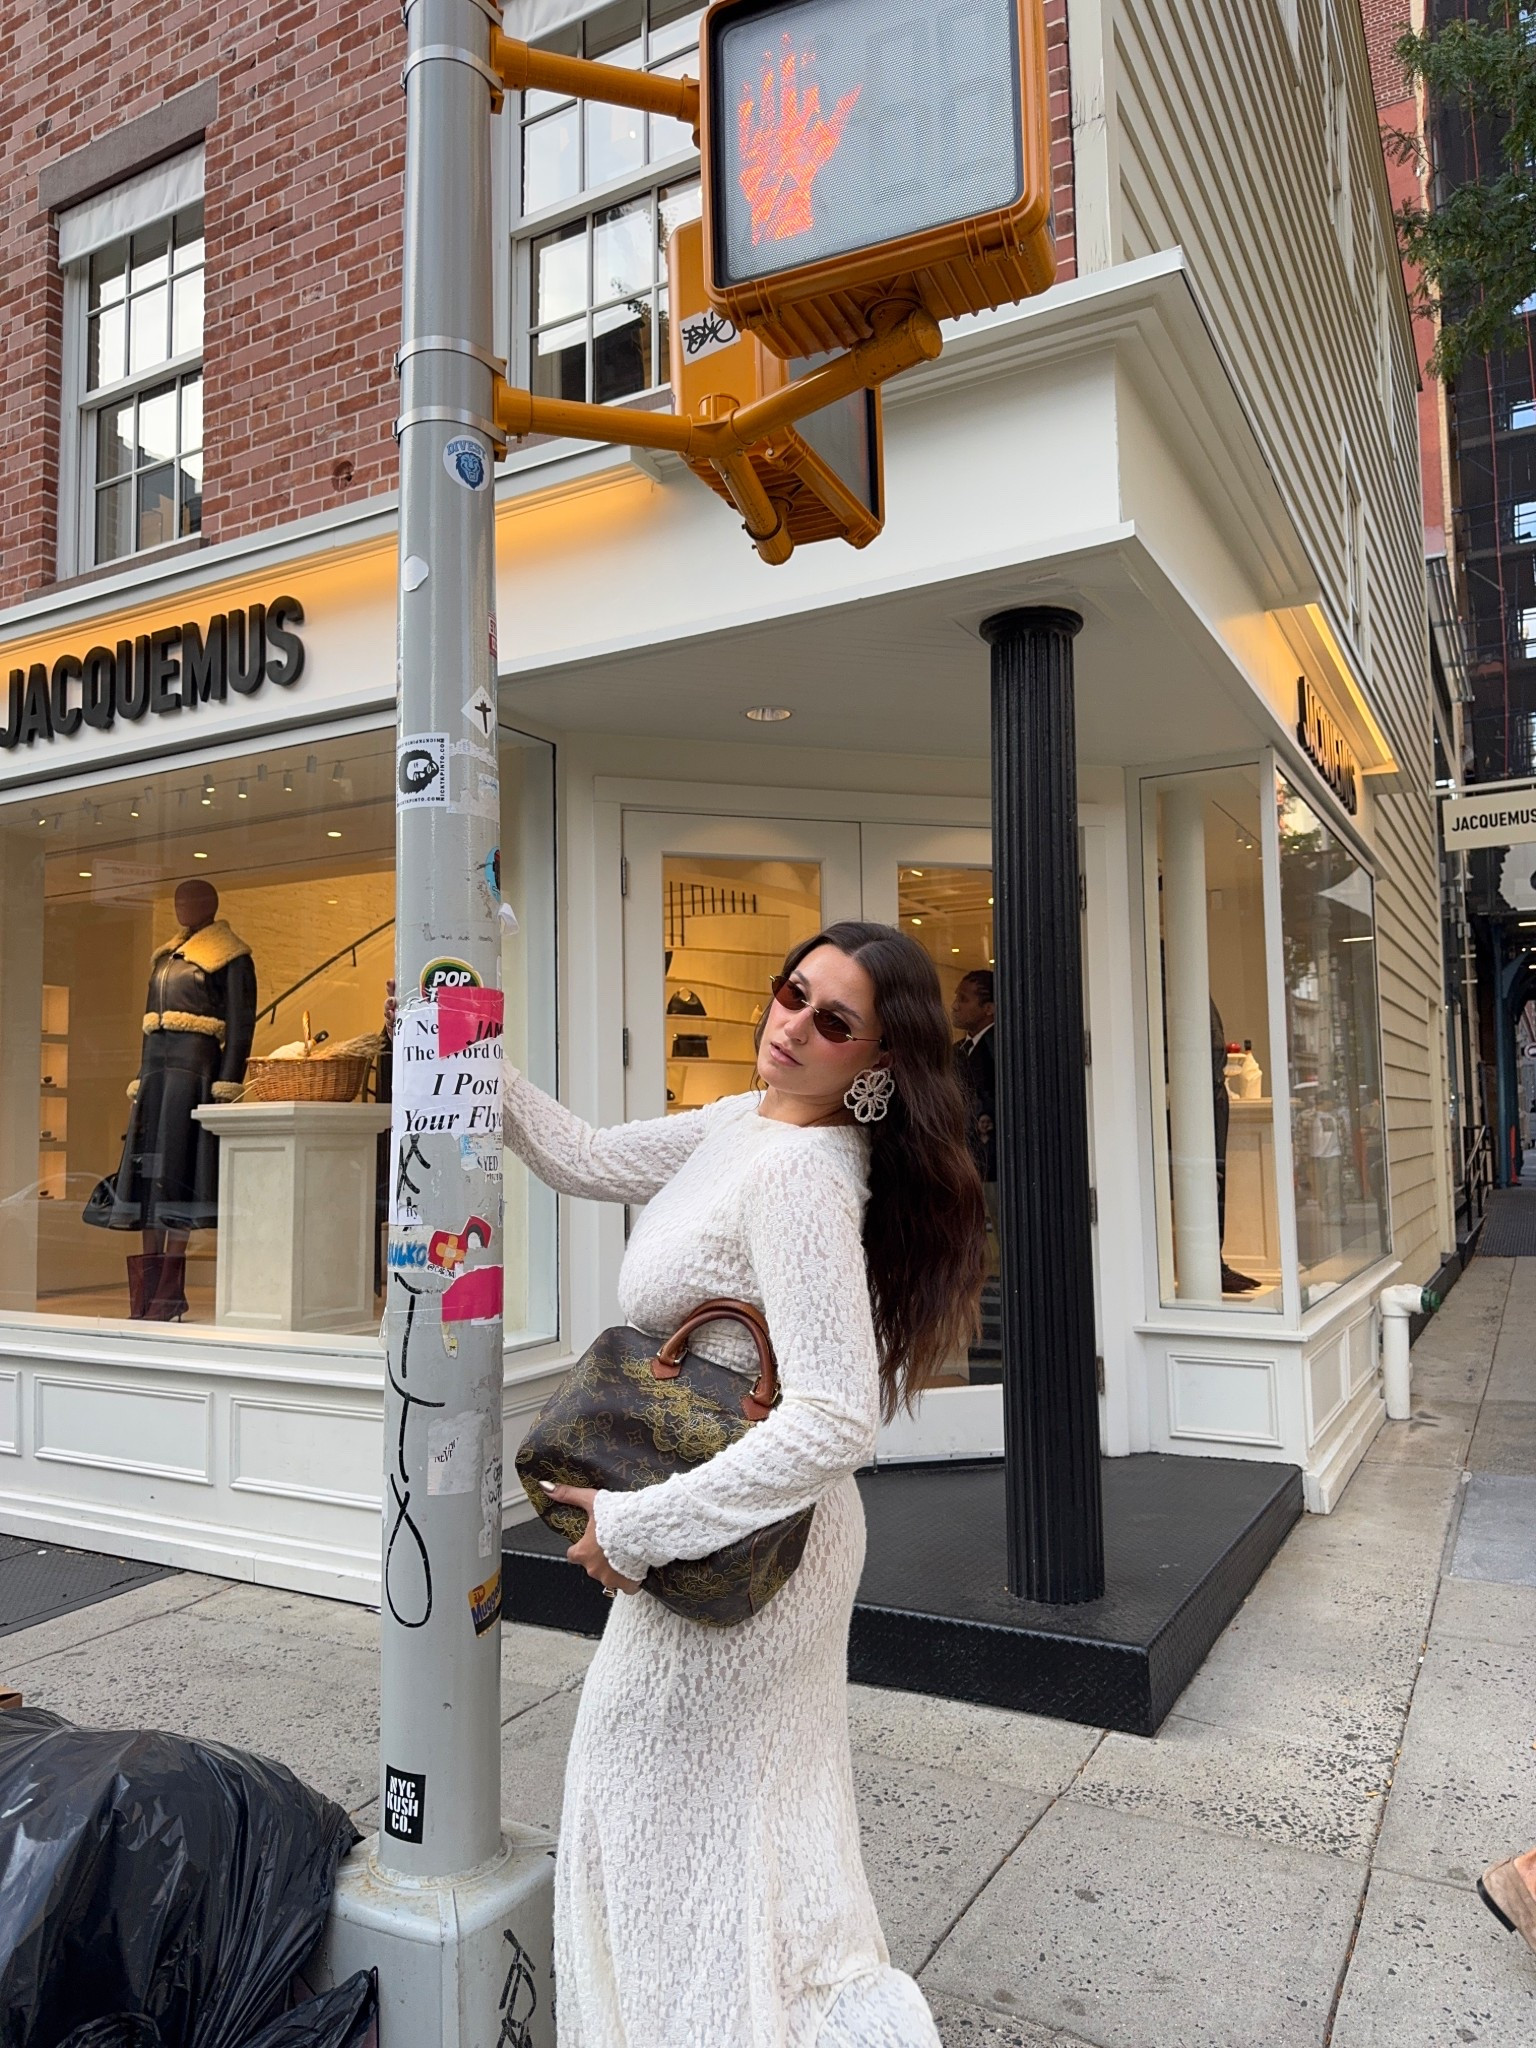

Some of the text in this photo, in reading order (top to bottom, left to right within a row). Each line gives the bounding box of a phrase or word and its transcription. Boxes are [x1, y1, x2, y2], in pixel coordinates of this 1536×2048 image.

[446, 440, 486, 460] DIVEST
[0, 595, 305, 748] JACQUEMUS
[1452, 808, 1536, 832] JACQUEMUS
[433, 971, 471, 987] POP
[416, 1020, 439, 1035] Ne
[404, 1045, 435, 1062] The
[446, 1044, 489, 1060] ord
[432, 1072, 499, 1096] I Post
[404, 1108, 460, 1133] Your
[389, 1776, 416, 1799] NYC
[386, 1791, 419, 1818] KUSH
[391, 1813, 412, 1834] CO.
